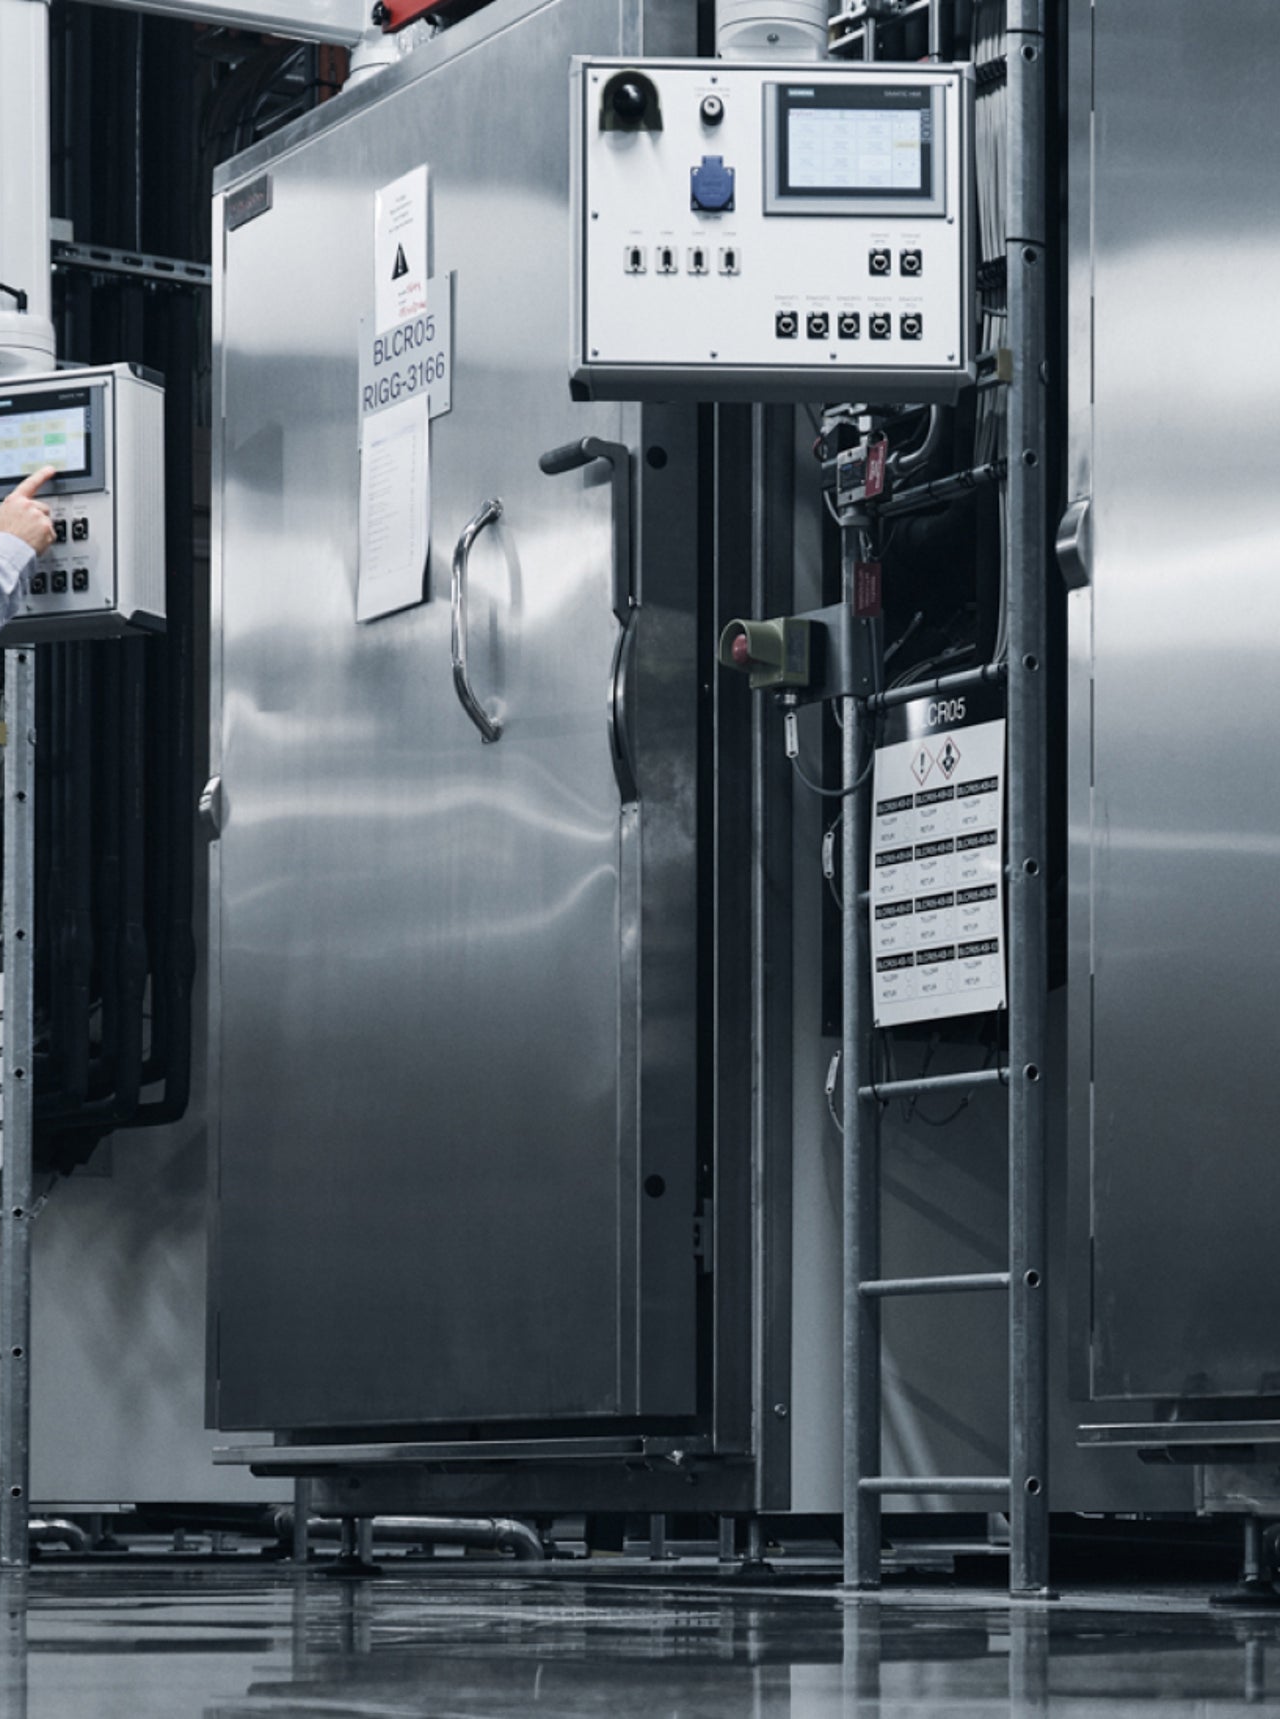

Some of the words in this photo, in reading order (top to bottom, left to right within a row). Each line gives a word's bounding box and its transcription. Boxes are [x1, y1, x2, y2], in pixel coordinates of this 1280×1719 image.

[373, 314, 435, 366] BLCR05
[363, 351, 445, 412] RIGG-3166
[920, 696, 967, 727] CR05
